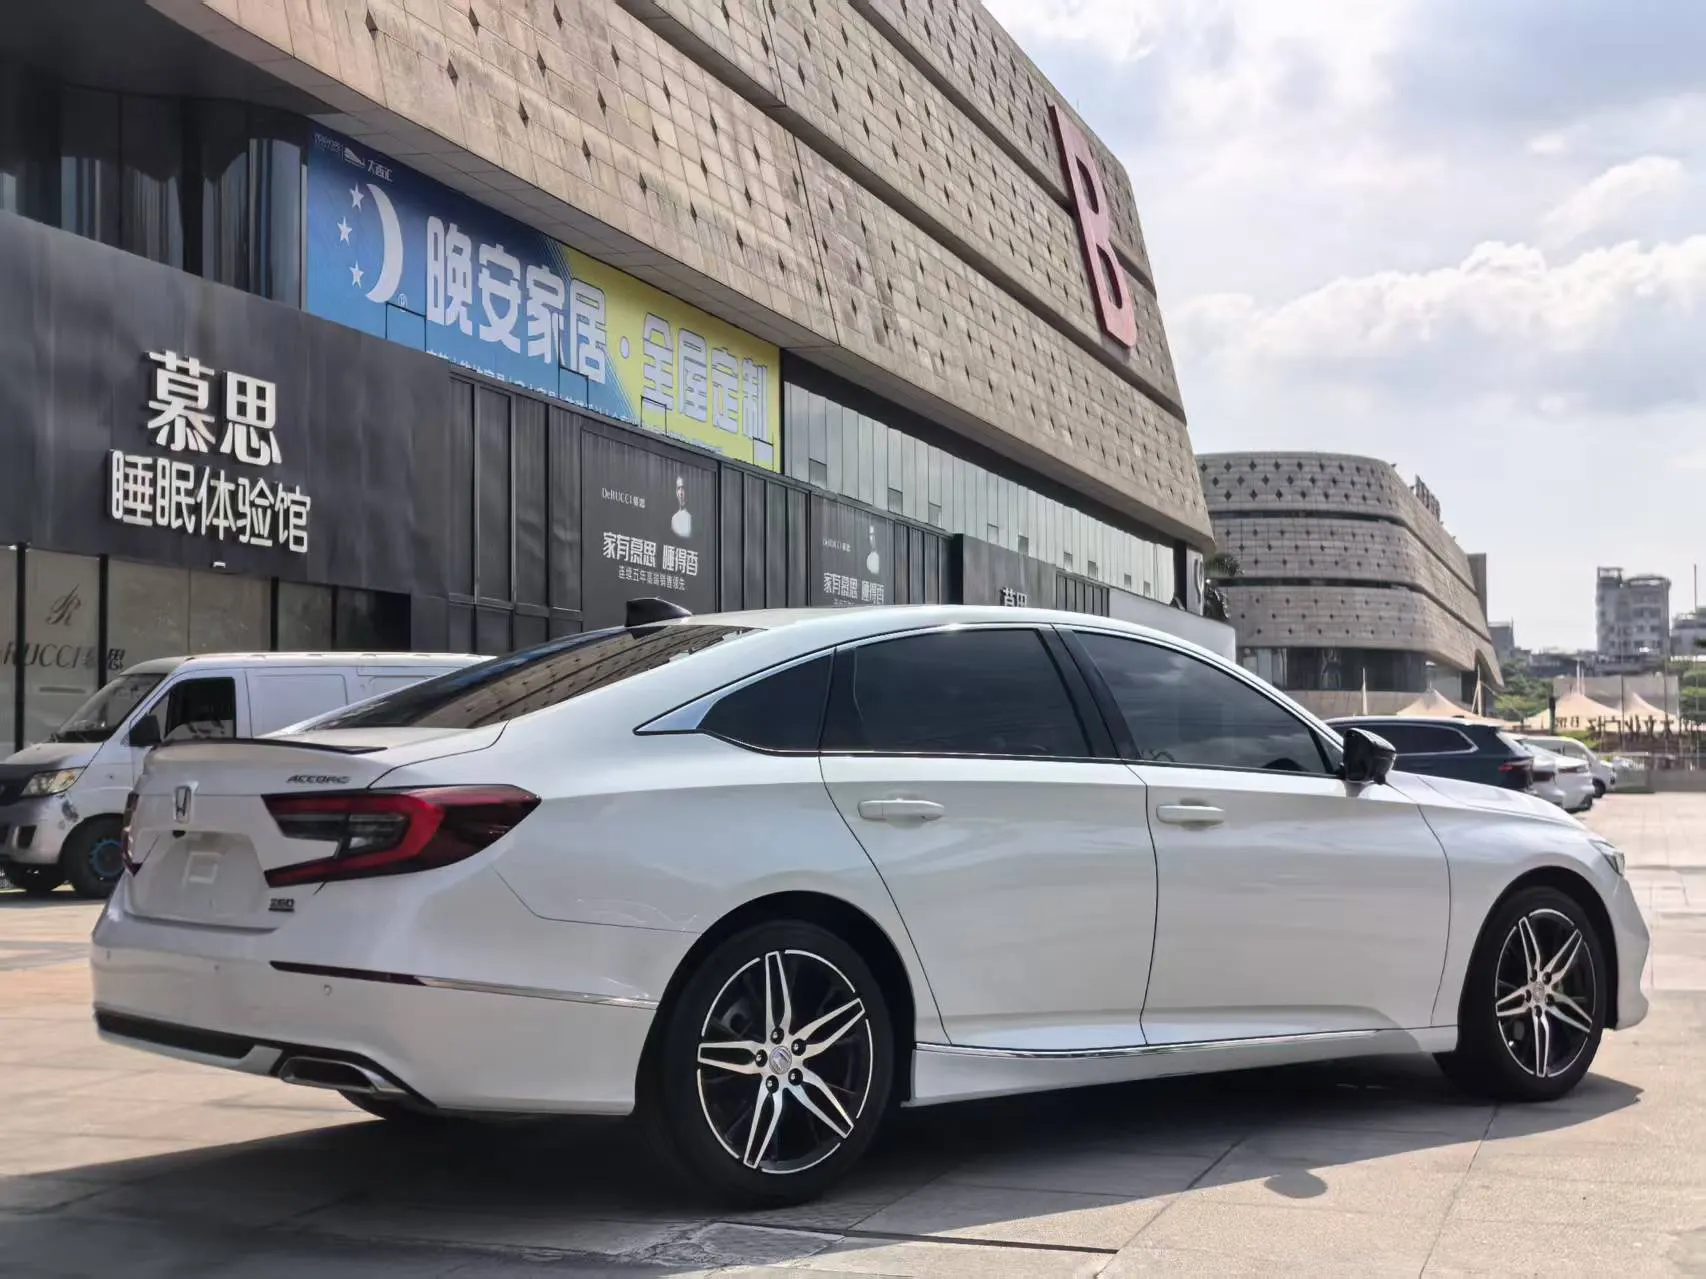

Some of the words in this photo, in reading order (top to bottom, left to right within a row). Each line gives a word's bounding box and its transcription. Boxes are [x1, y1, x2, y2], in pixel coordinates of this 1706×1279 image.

[1050, 105, 1138, 347] B
[147, 349, 282, 465] 慕思
[111, 450, 312, 553] 睡眠体验馆
[603, 531, 657, 567] 家有慕思
[662, 544, 699, 576] 睡得香
